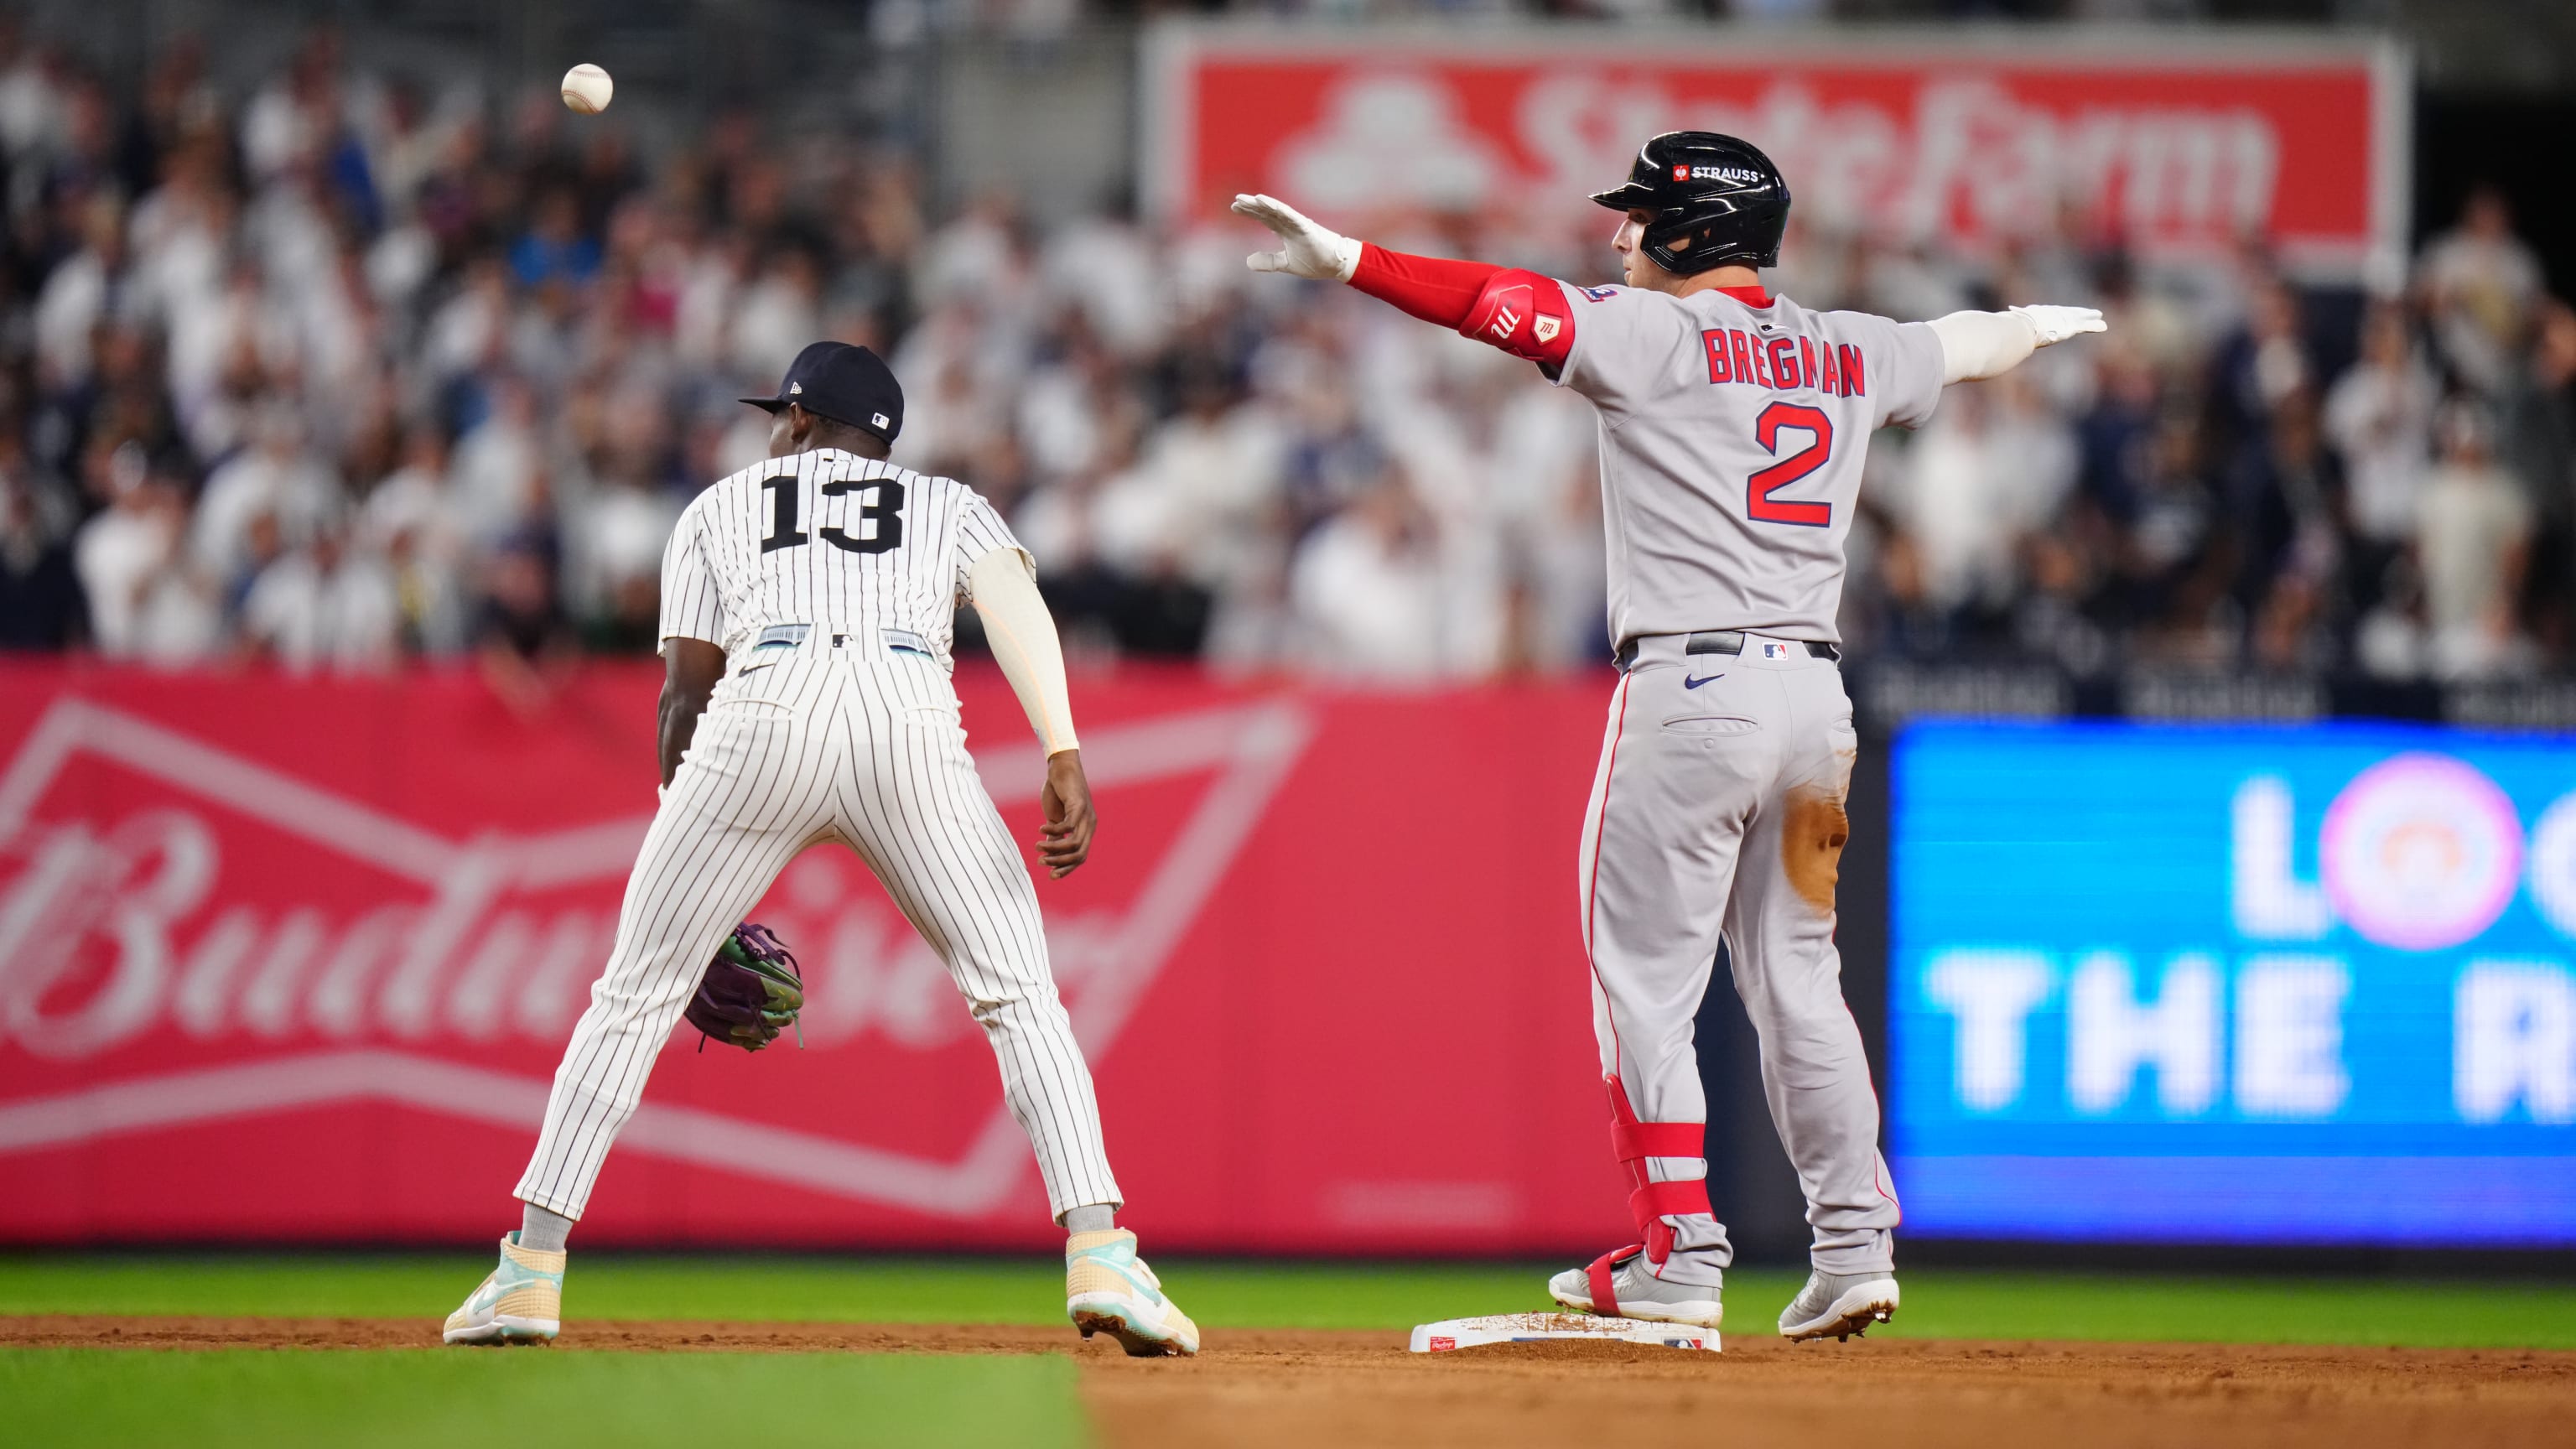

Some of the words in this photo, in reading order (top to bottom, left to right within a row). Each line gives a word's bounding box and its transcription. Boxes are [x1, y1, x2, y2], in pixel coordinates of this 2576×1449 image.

[1691, 166, 1759, 183] STRAUSS
[1701, 327, 1866, 398] BREGMAN
[1746, 400, 1834, 528] 2
[761, 475, 906, 555] 13
[1924, 950, 2350, 1116] THE
